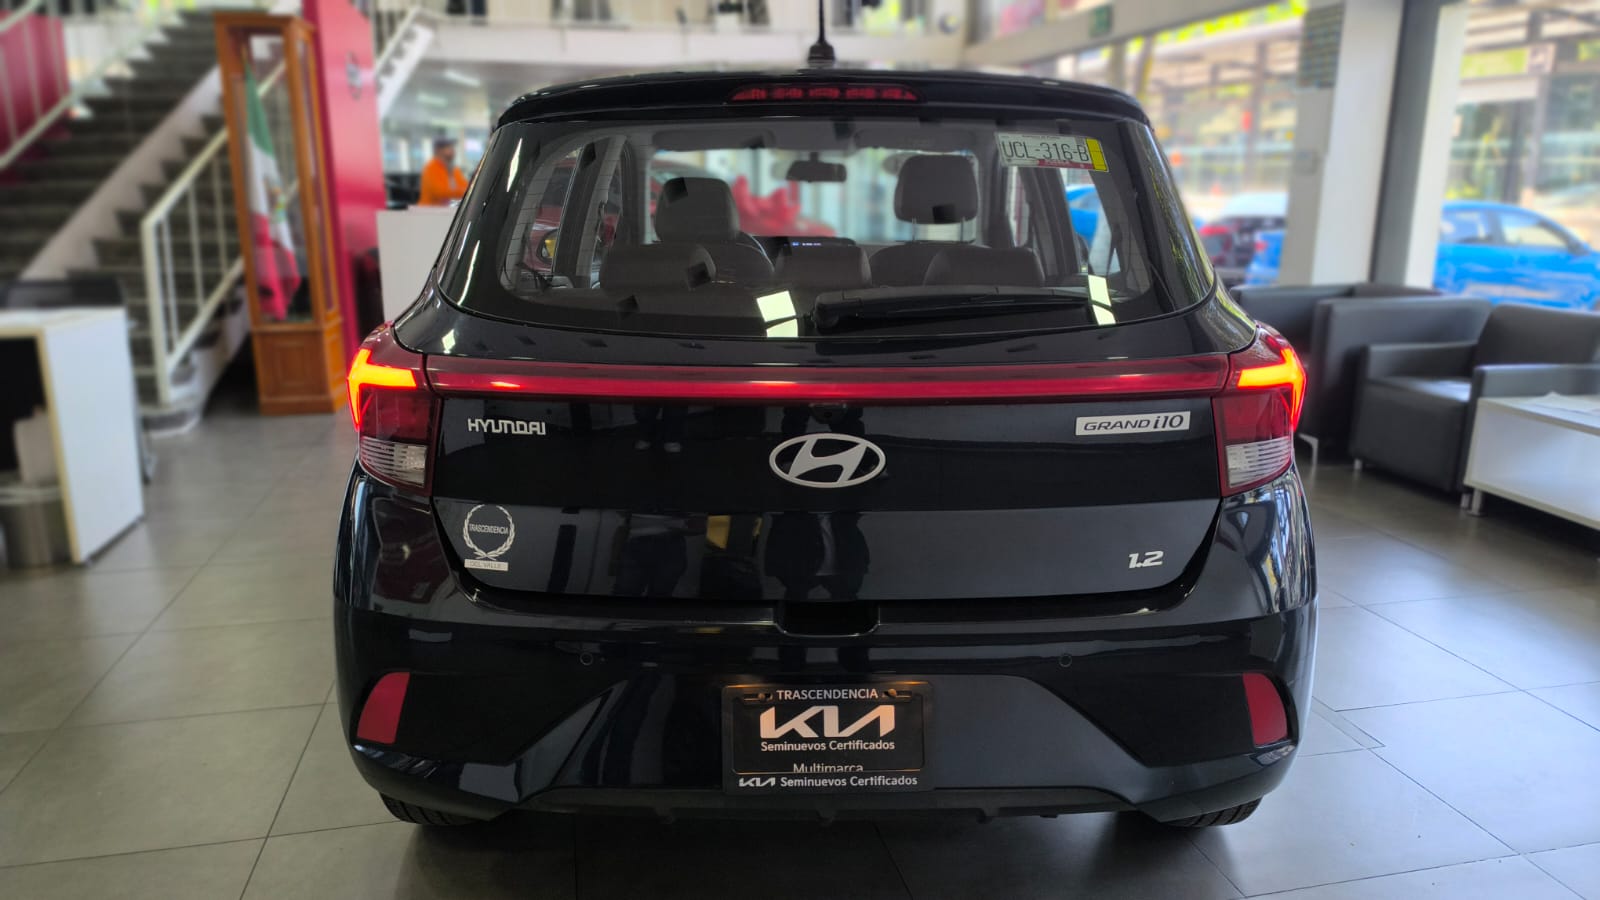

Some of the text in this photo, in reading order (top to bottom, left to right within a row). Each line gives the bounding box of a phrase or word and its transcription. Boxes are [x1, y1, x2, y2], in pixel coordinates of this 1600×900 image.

[1001, 141, 1089, 161] UCL-316-B
[467, 418, 546, 436] HYUNDAI
[1083, 414, 1184, 431] GRAND i10
[469, 523, 509, 535] TRASCENDENCIA
[1128, 550, 1164, 569] 1.2
[776, 688, 879, 701] TRASCENDENCIA
[760, 704, 896, 739] KIA
[761, 739, 895, 752] Seminuevos Certificados
[793, 763, 864, 773] Multimarca
[739, 774, 918, 787] KIA Seminuevos Certificados
